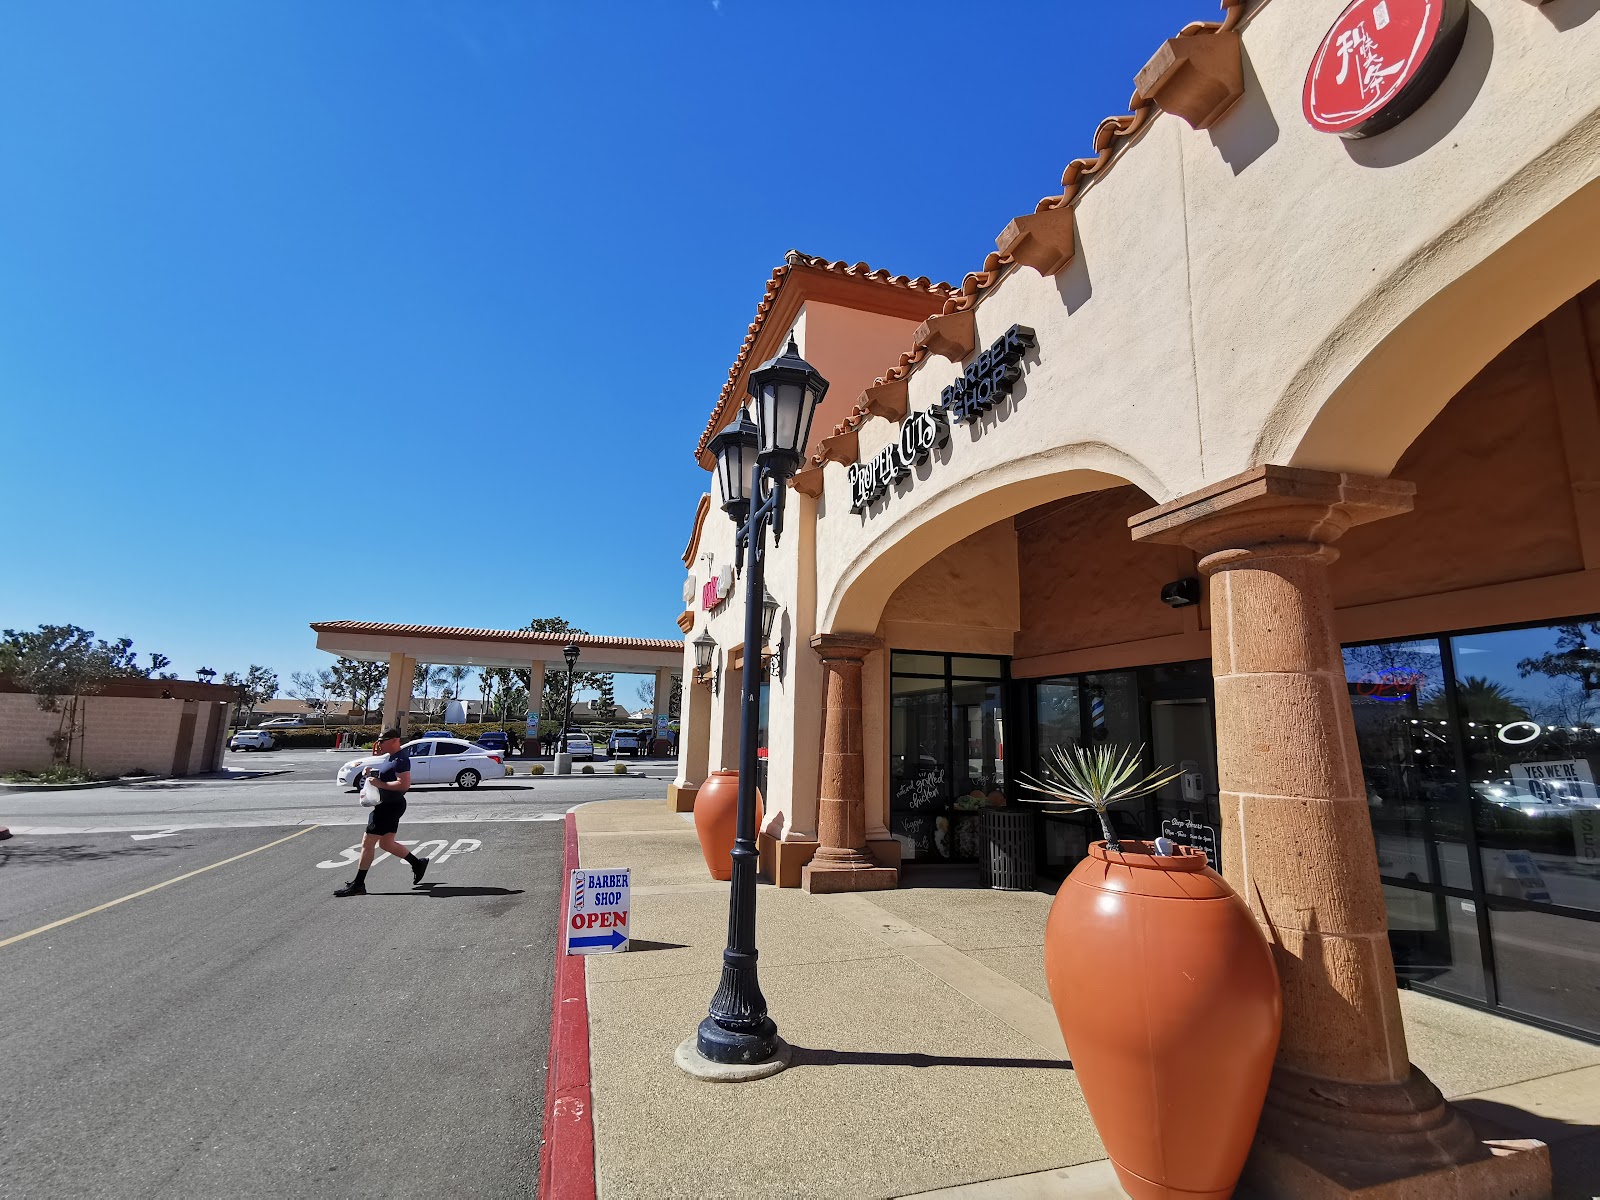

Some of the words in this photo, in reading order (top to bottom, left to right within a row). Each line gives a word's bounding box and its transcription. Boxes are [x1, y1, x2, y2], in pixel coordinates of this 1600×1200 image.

[941, 323, 1020, 410] BARBER
[953, 364, 1007, 424] SHOP
[848, 443, 899, 506] PROPER
[897, 405, 937, 466] CUTS
[915, 768, 945, 794] grilled
[1524, 765, 1545, 779] YES
[1544, 763, 1578, 778] WE'RE
[909, 786, 940, 809] chicken
[315, 838, 482, 869] STOP
[588, 874, 629, 889] BARBER
[594, 891, 622, 906] SHOP
[571, 910, 628, 930] OPEN
